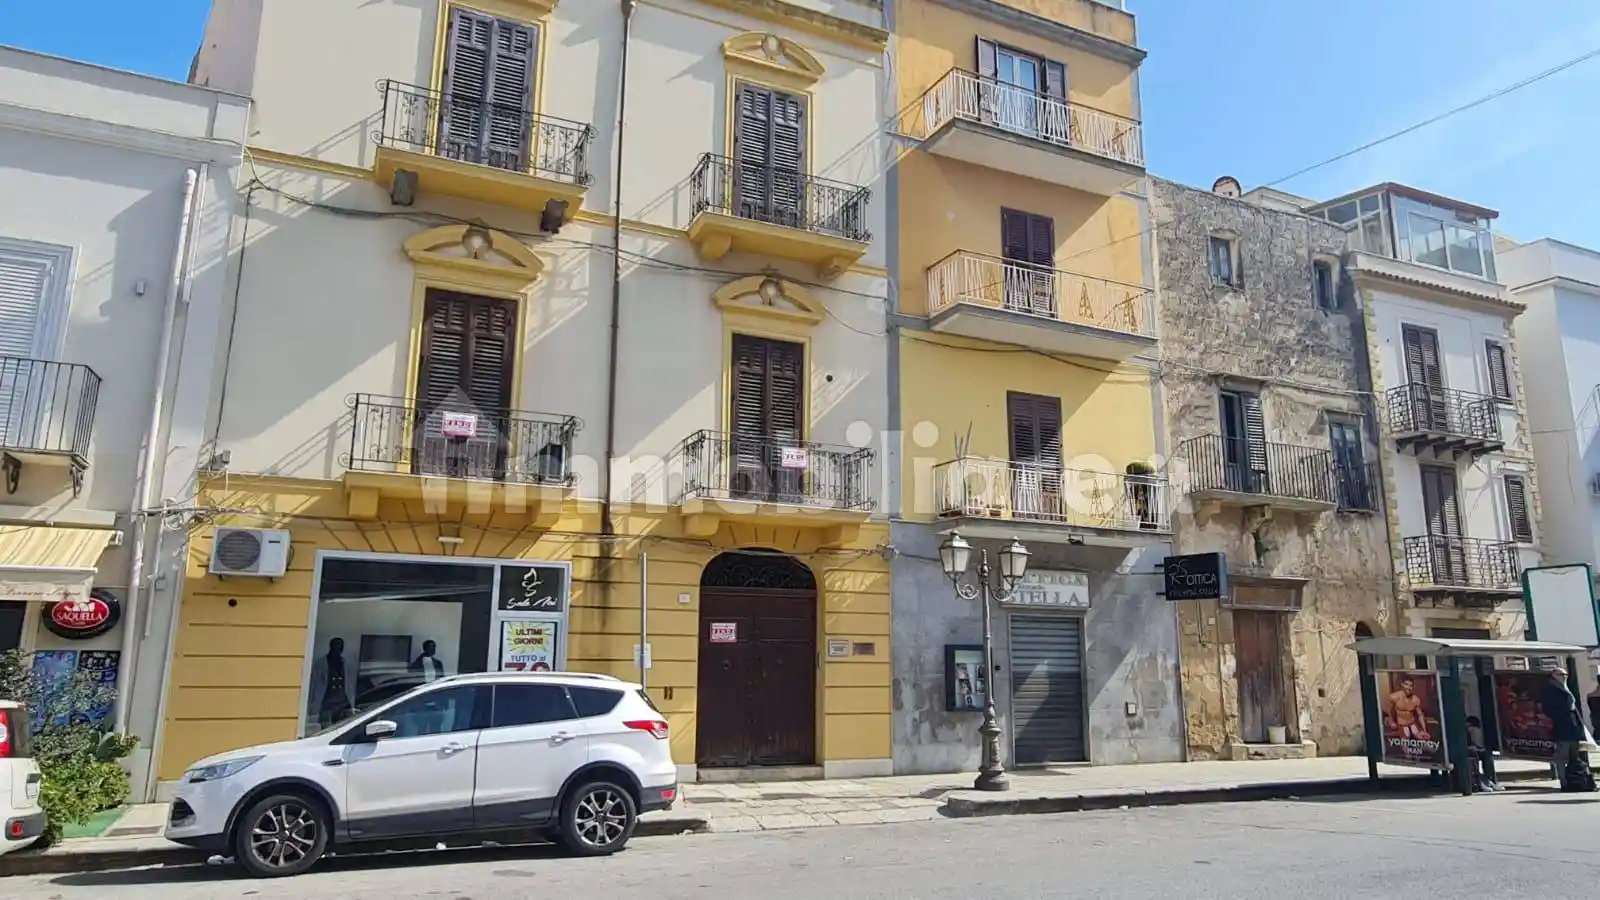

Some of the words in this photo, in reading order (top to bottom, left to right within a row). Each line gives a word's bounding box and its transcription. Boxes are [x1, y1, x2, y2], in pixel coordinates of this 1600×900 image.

[56, 611, 103, 622] SAQUELLA
[515, 628, 543, 636] ULTIMI
[1388, 738, 1440, 751] yamamay
